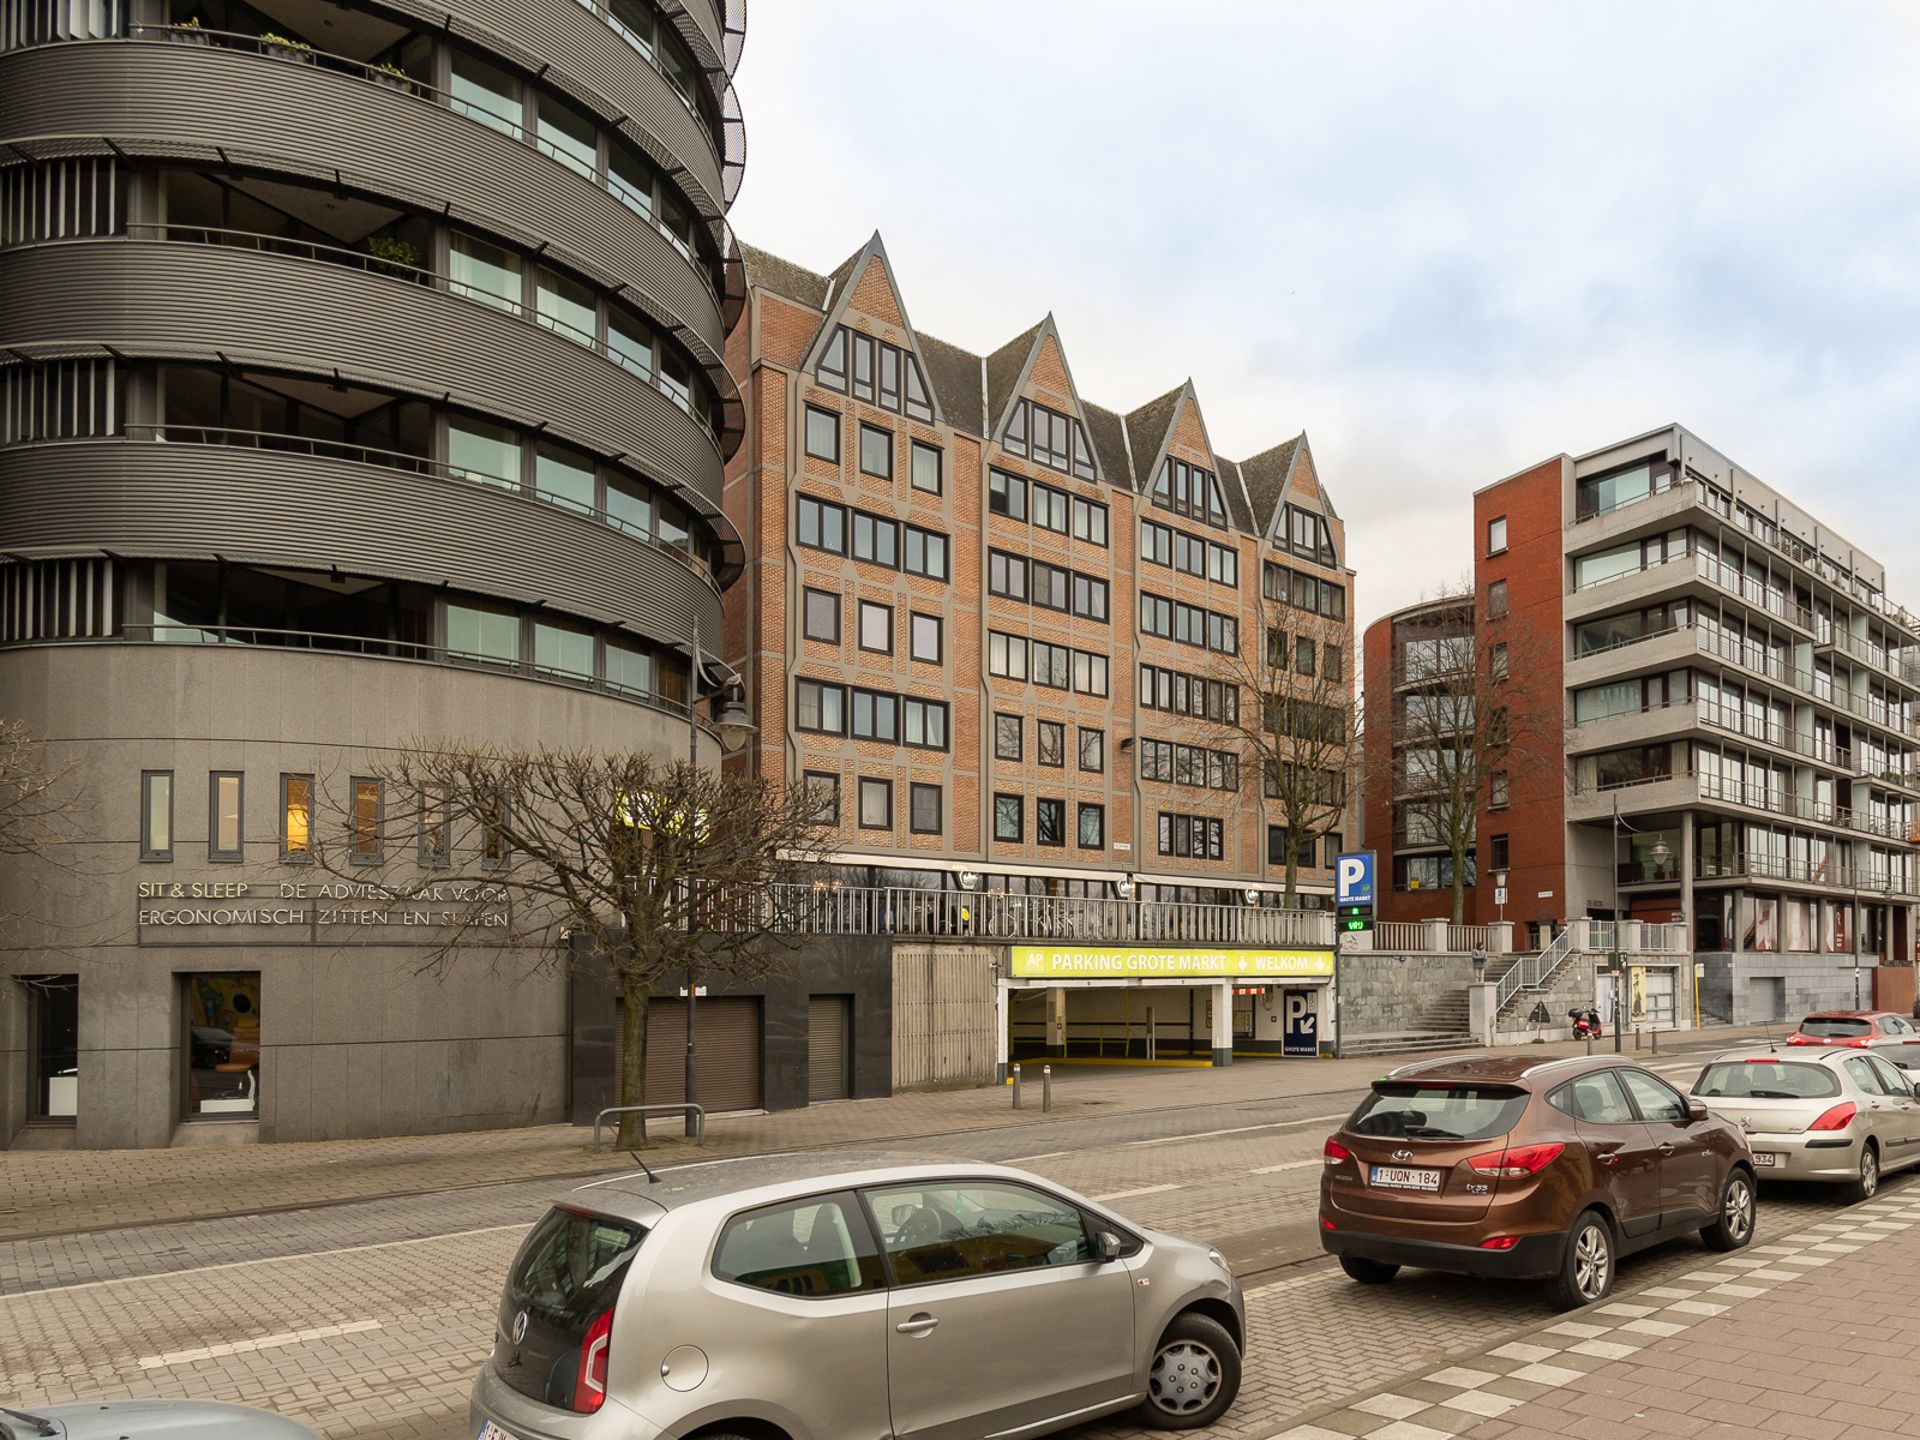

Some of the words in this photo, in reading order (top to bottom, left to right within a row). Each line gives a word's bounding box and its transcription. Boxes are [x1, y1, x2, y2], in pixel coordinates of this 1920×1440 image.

[1340, 858, 1365, 896] P
[138, 882, 166, 898] SIT
[170, 882, 185, 898] &
[192, 882, 248, 898] SLEEP
[280, 883, 307, 899] DE
[451, 886, 507, 902] VOOR
[139, 909, 304, 925] ERGONOMISCH
[318, 910, 388, 925] ZITTEN
[403, 910, 430, 925] EN
[1028, 953, 1043, 965] AP
[1052, 953, 1123, 971] PARKING
[1127, 954, 1175, 971] GROTE
[1178, 955, 1227, 971] MARKT
[1255, 956, 1308, 970] WELKOM
[1286, 995, 1307, 1034] P
[1755, 1155, 1773, 1163] 934
